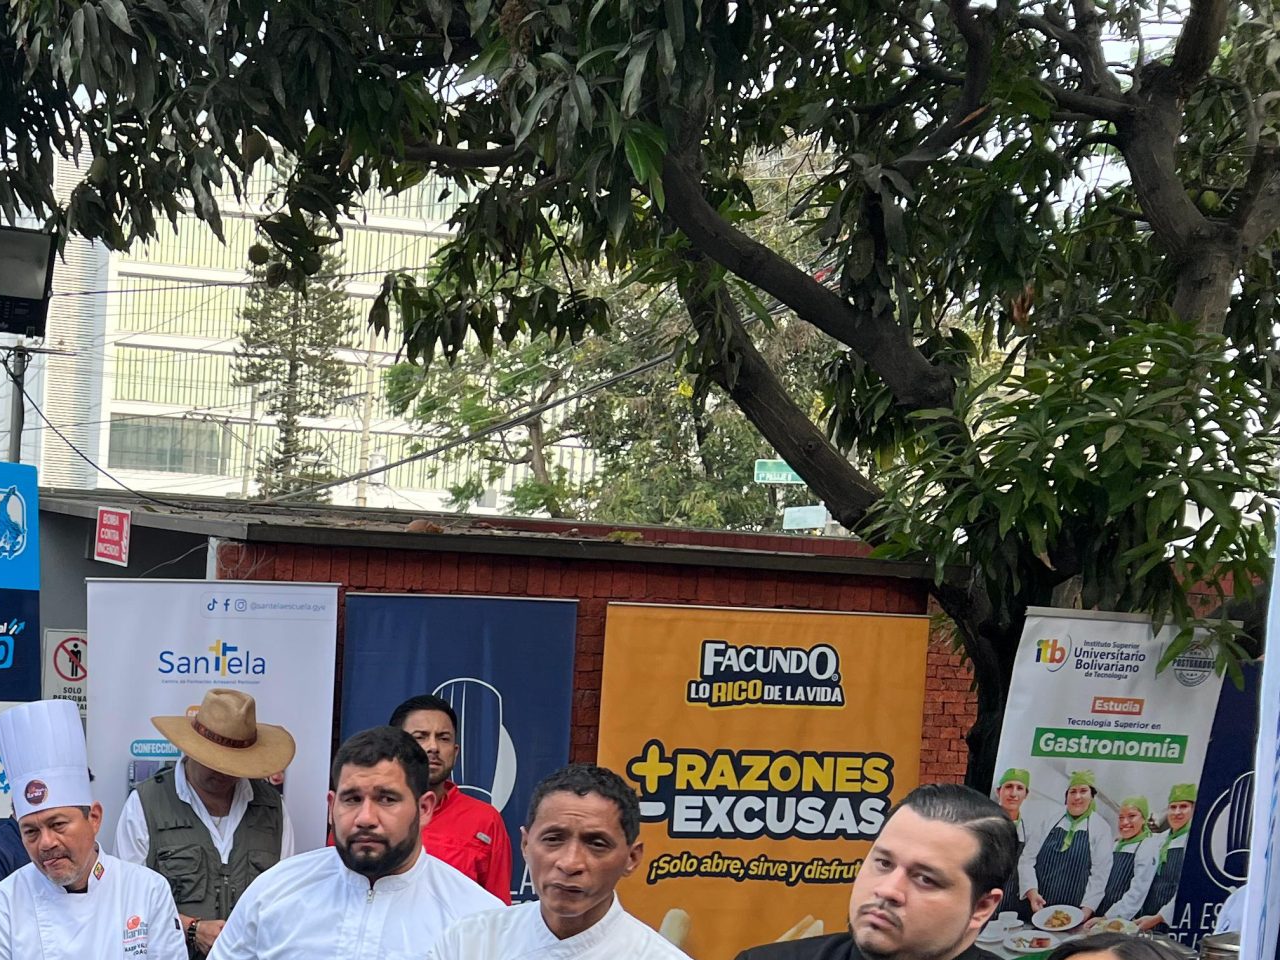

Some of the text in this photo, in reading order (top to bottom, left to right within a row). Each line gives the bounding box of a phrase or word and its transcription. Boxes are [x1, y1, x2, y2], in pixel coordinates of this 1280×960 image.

[703, 642, 837, 680] FACUNDO
[1074, 647, 1146, 662] Universitario
[1075, 659, 1140, 673] Bolivariano
[690, 683, 710, 698] LO
[712, 679, 763, 703] RICO
[763, 685, 783, 700] DE
[1094, 700, 1140, 713] Estudia
[1114, 719, 1149, 730] Superior
[1151, 723, 1162, 731] en
[1039, 732, 1181, 759] Gastronomía
[650, 856, 862, 882] ¡Solo abre, sirve y disfrut
